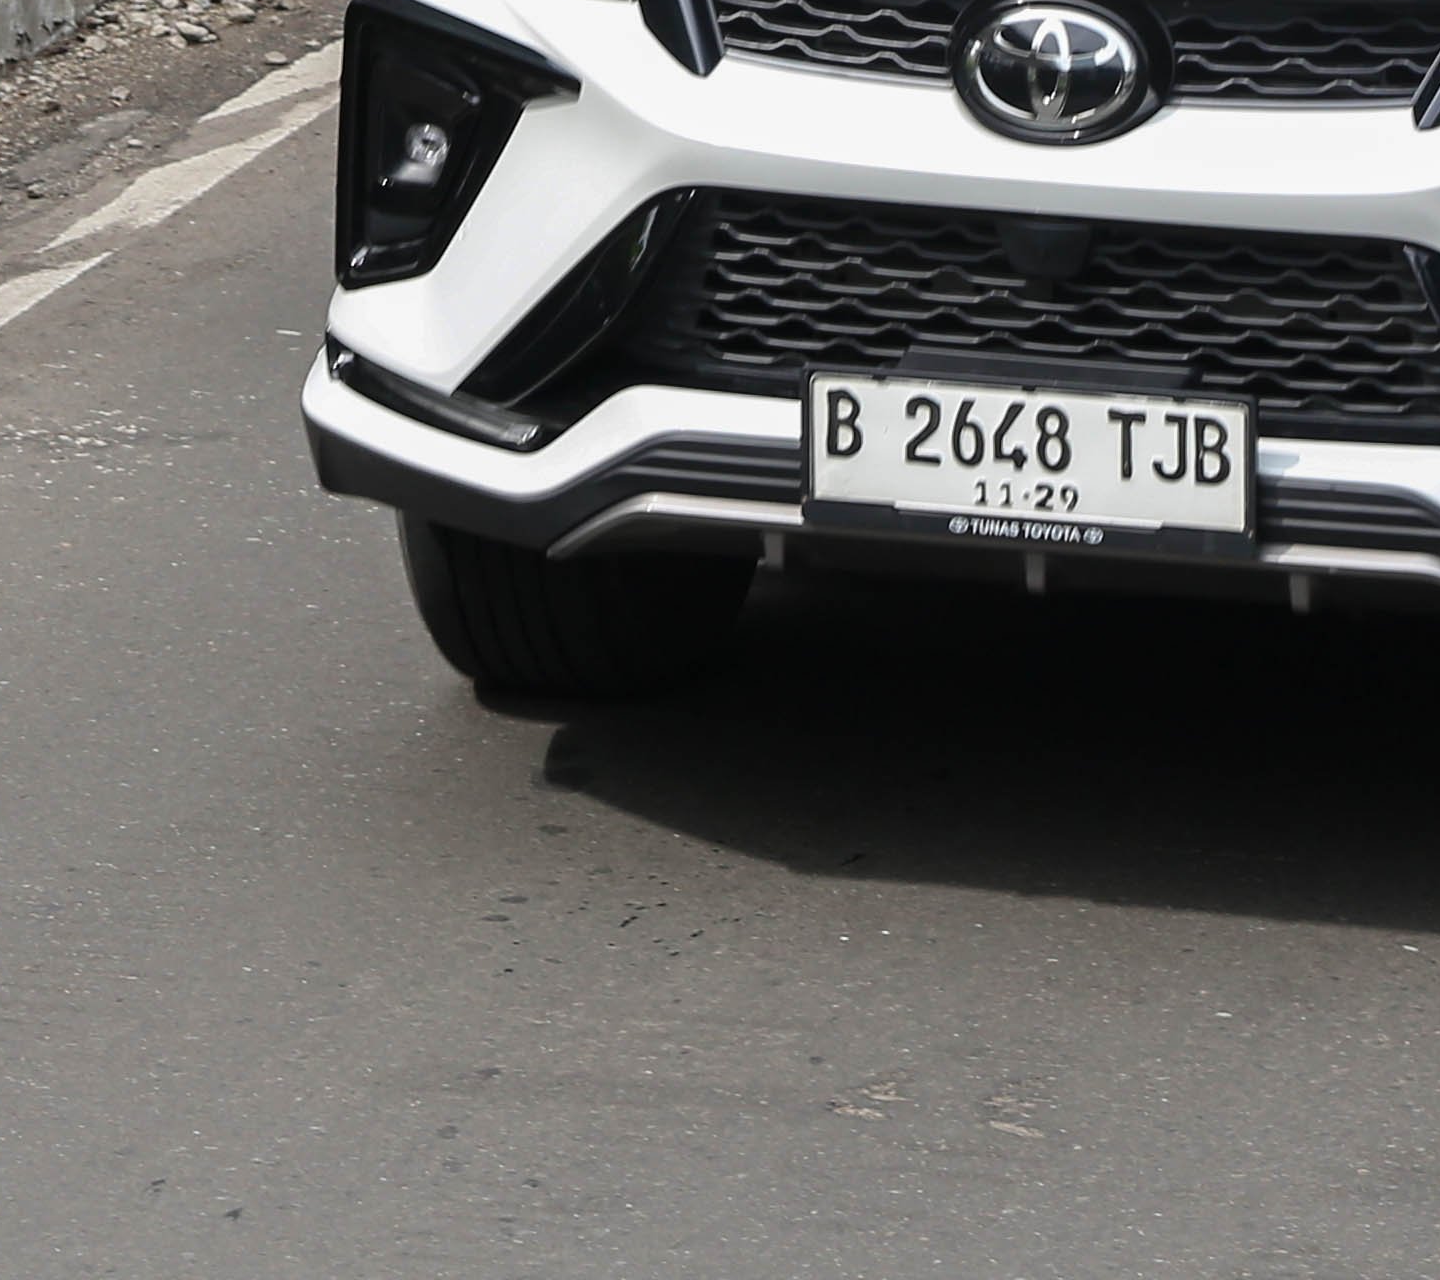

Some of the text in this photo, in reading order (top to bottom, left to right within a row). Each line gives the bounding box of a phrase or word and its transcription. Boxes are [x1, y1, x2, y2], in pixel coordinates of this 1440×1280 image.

[825, 388, 1232, 486] B 2648 TJB
[971, 518, 1081, 544] TUNAS TOYOTA
